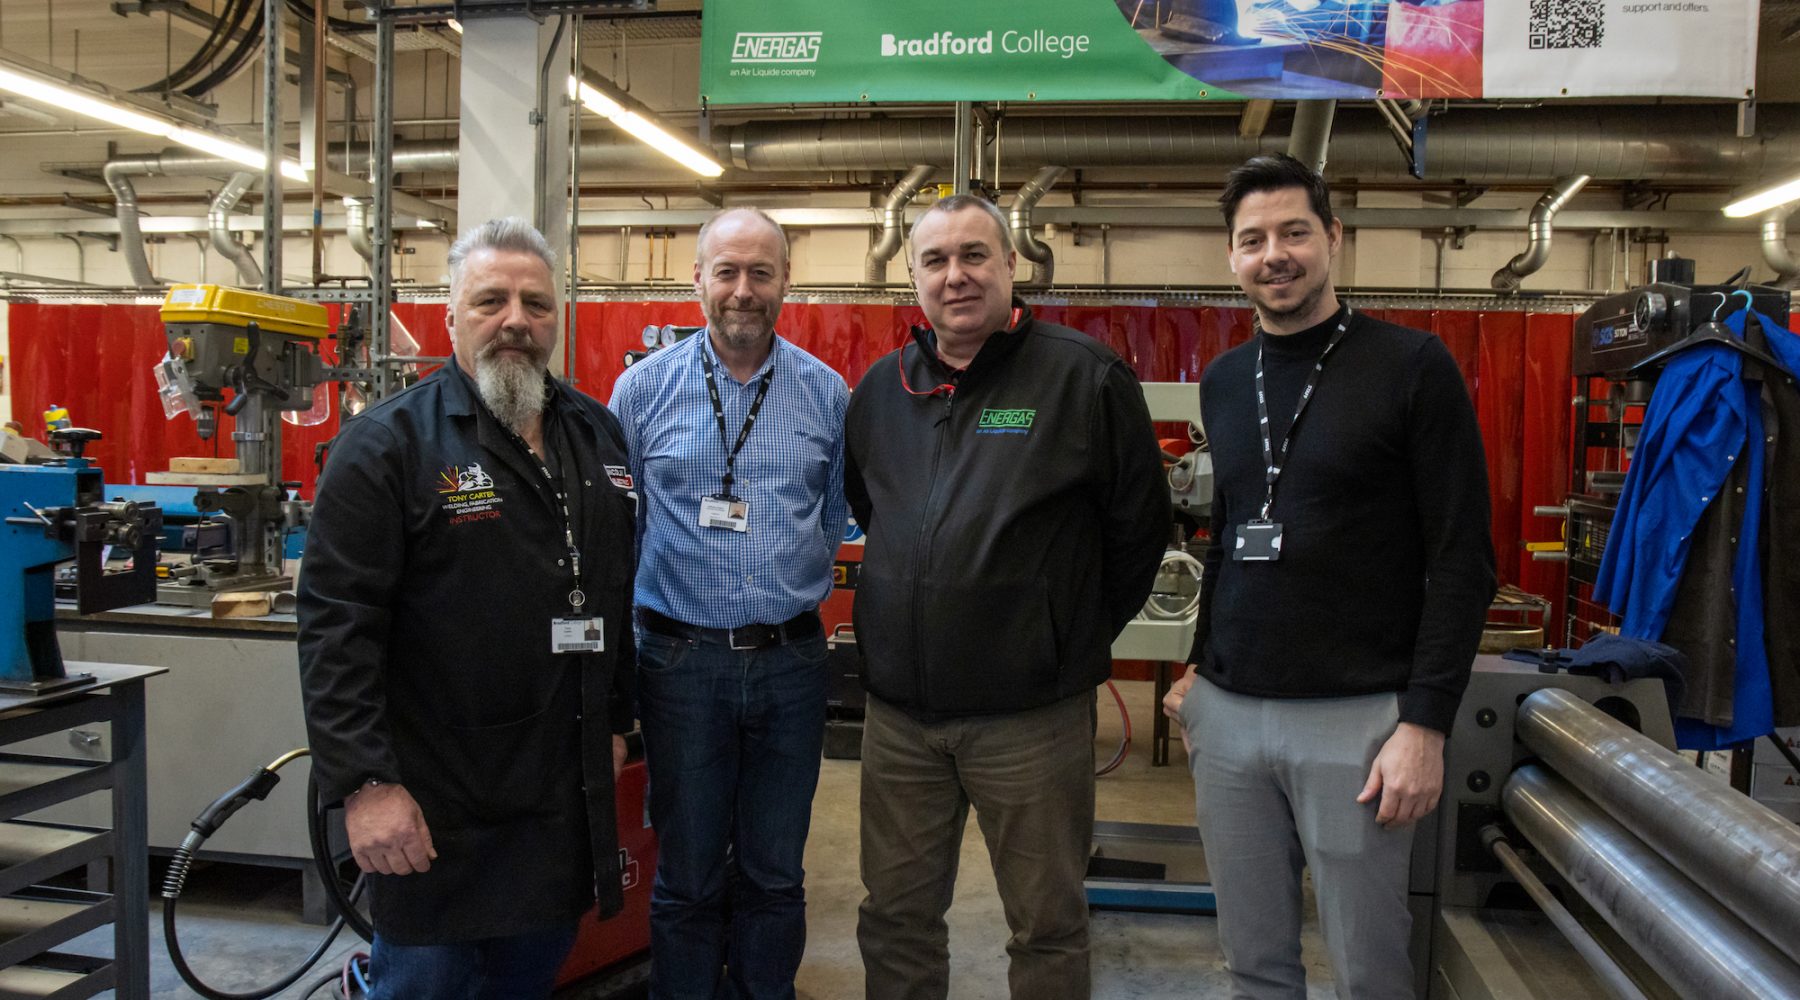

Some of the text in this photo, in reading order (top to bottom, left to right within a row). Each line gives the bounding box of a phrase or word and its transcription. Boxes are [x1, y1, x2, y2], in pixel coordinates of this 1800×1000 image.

[1622, 3, 1662, 13] support
[1663, 2, 1682, 11] and
[731, 32, 823, 63] ENERGAS
[881, 29, 1090, 58] Bradford College
[741, 68, 751, 76] Air
[752, 67, 780, 77] Liquide
[781, 69, 816, 77] company
[979, 408, 1037, 428] ENERGAS
[447, 491, 496, 503] TONY CARTER
[469, 497, 504, 507] FABRICATION
[456, 504, 492, 515] ENGINEERING
[449, 511, 502, 525] INSTRUCTOR
